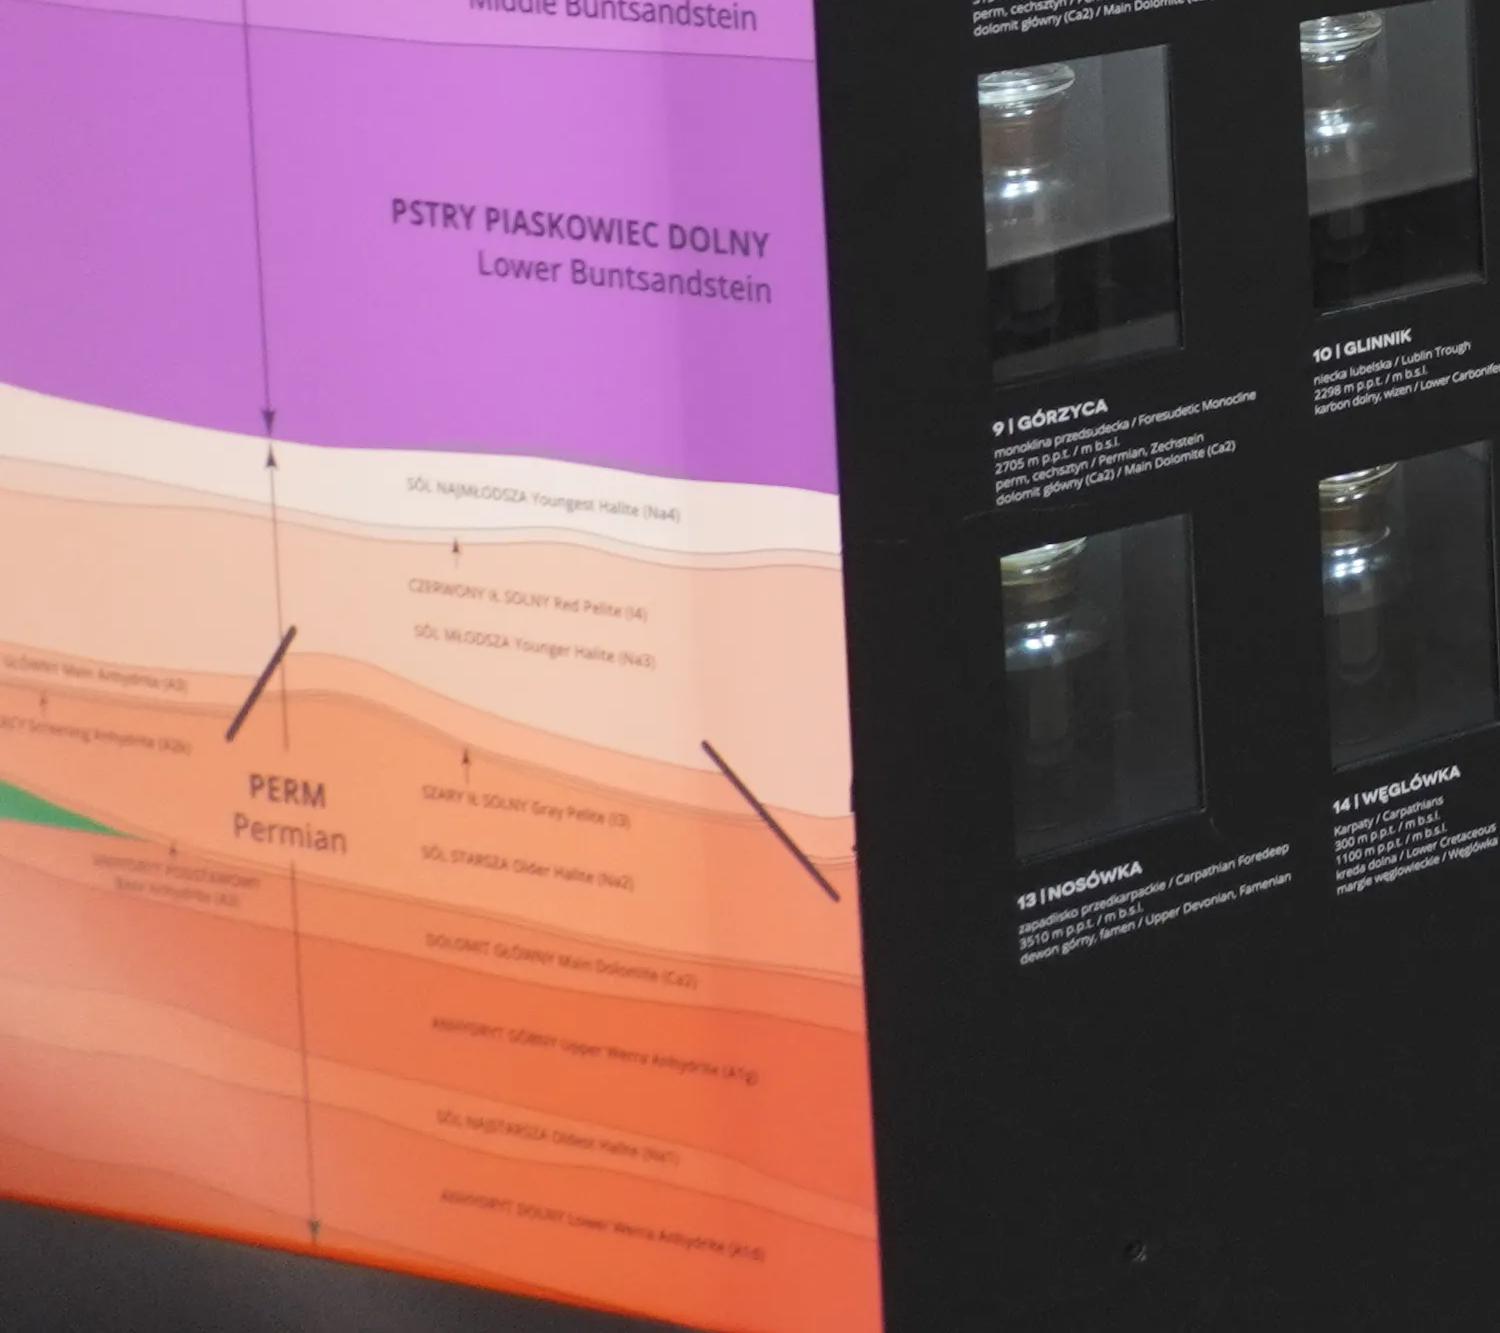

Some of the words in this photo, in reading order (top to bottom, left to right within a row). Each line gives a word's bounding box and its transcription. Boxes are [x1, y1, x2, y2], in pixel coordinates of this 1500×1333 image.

[392, 197, 476, 230] PSTRY
[485, 206, 659, 249] PIASKOWIEC
[668, 223, 769, 259] DOLNY
[478, 250, 562, 283] Lower
[570, 258, 772, 305] Buntsandstein
[1312, 346, 1333, 363] 10
[1343, 327, 1412, 356] GLINNIK
[992, 421, 1005, 436] 9
[1017, 398, 1109, 431] GÓRZYCA
[249, 772, 326, 808] PERM
[1332, 797, 1351, 815] 14
[1361, 764, 1461, 806] WĘGLÓWKA
[233, 811, 348, 855] Permian
[1017, 891, 1037, 909] 13
[1048, 860, 1143, 902] NOSÓWKA
